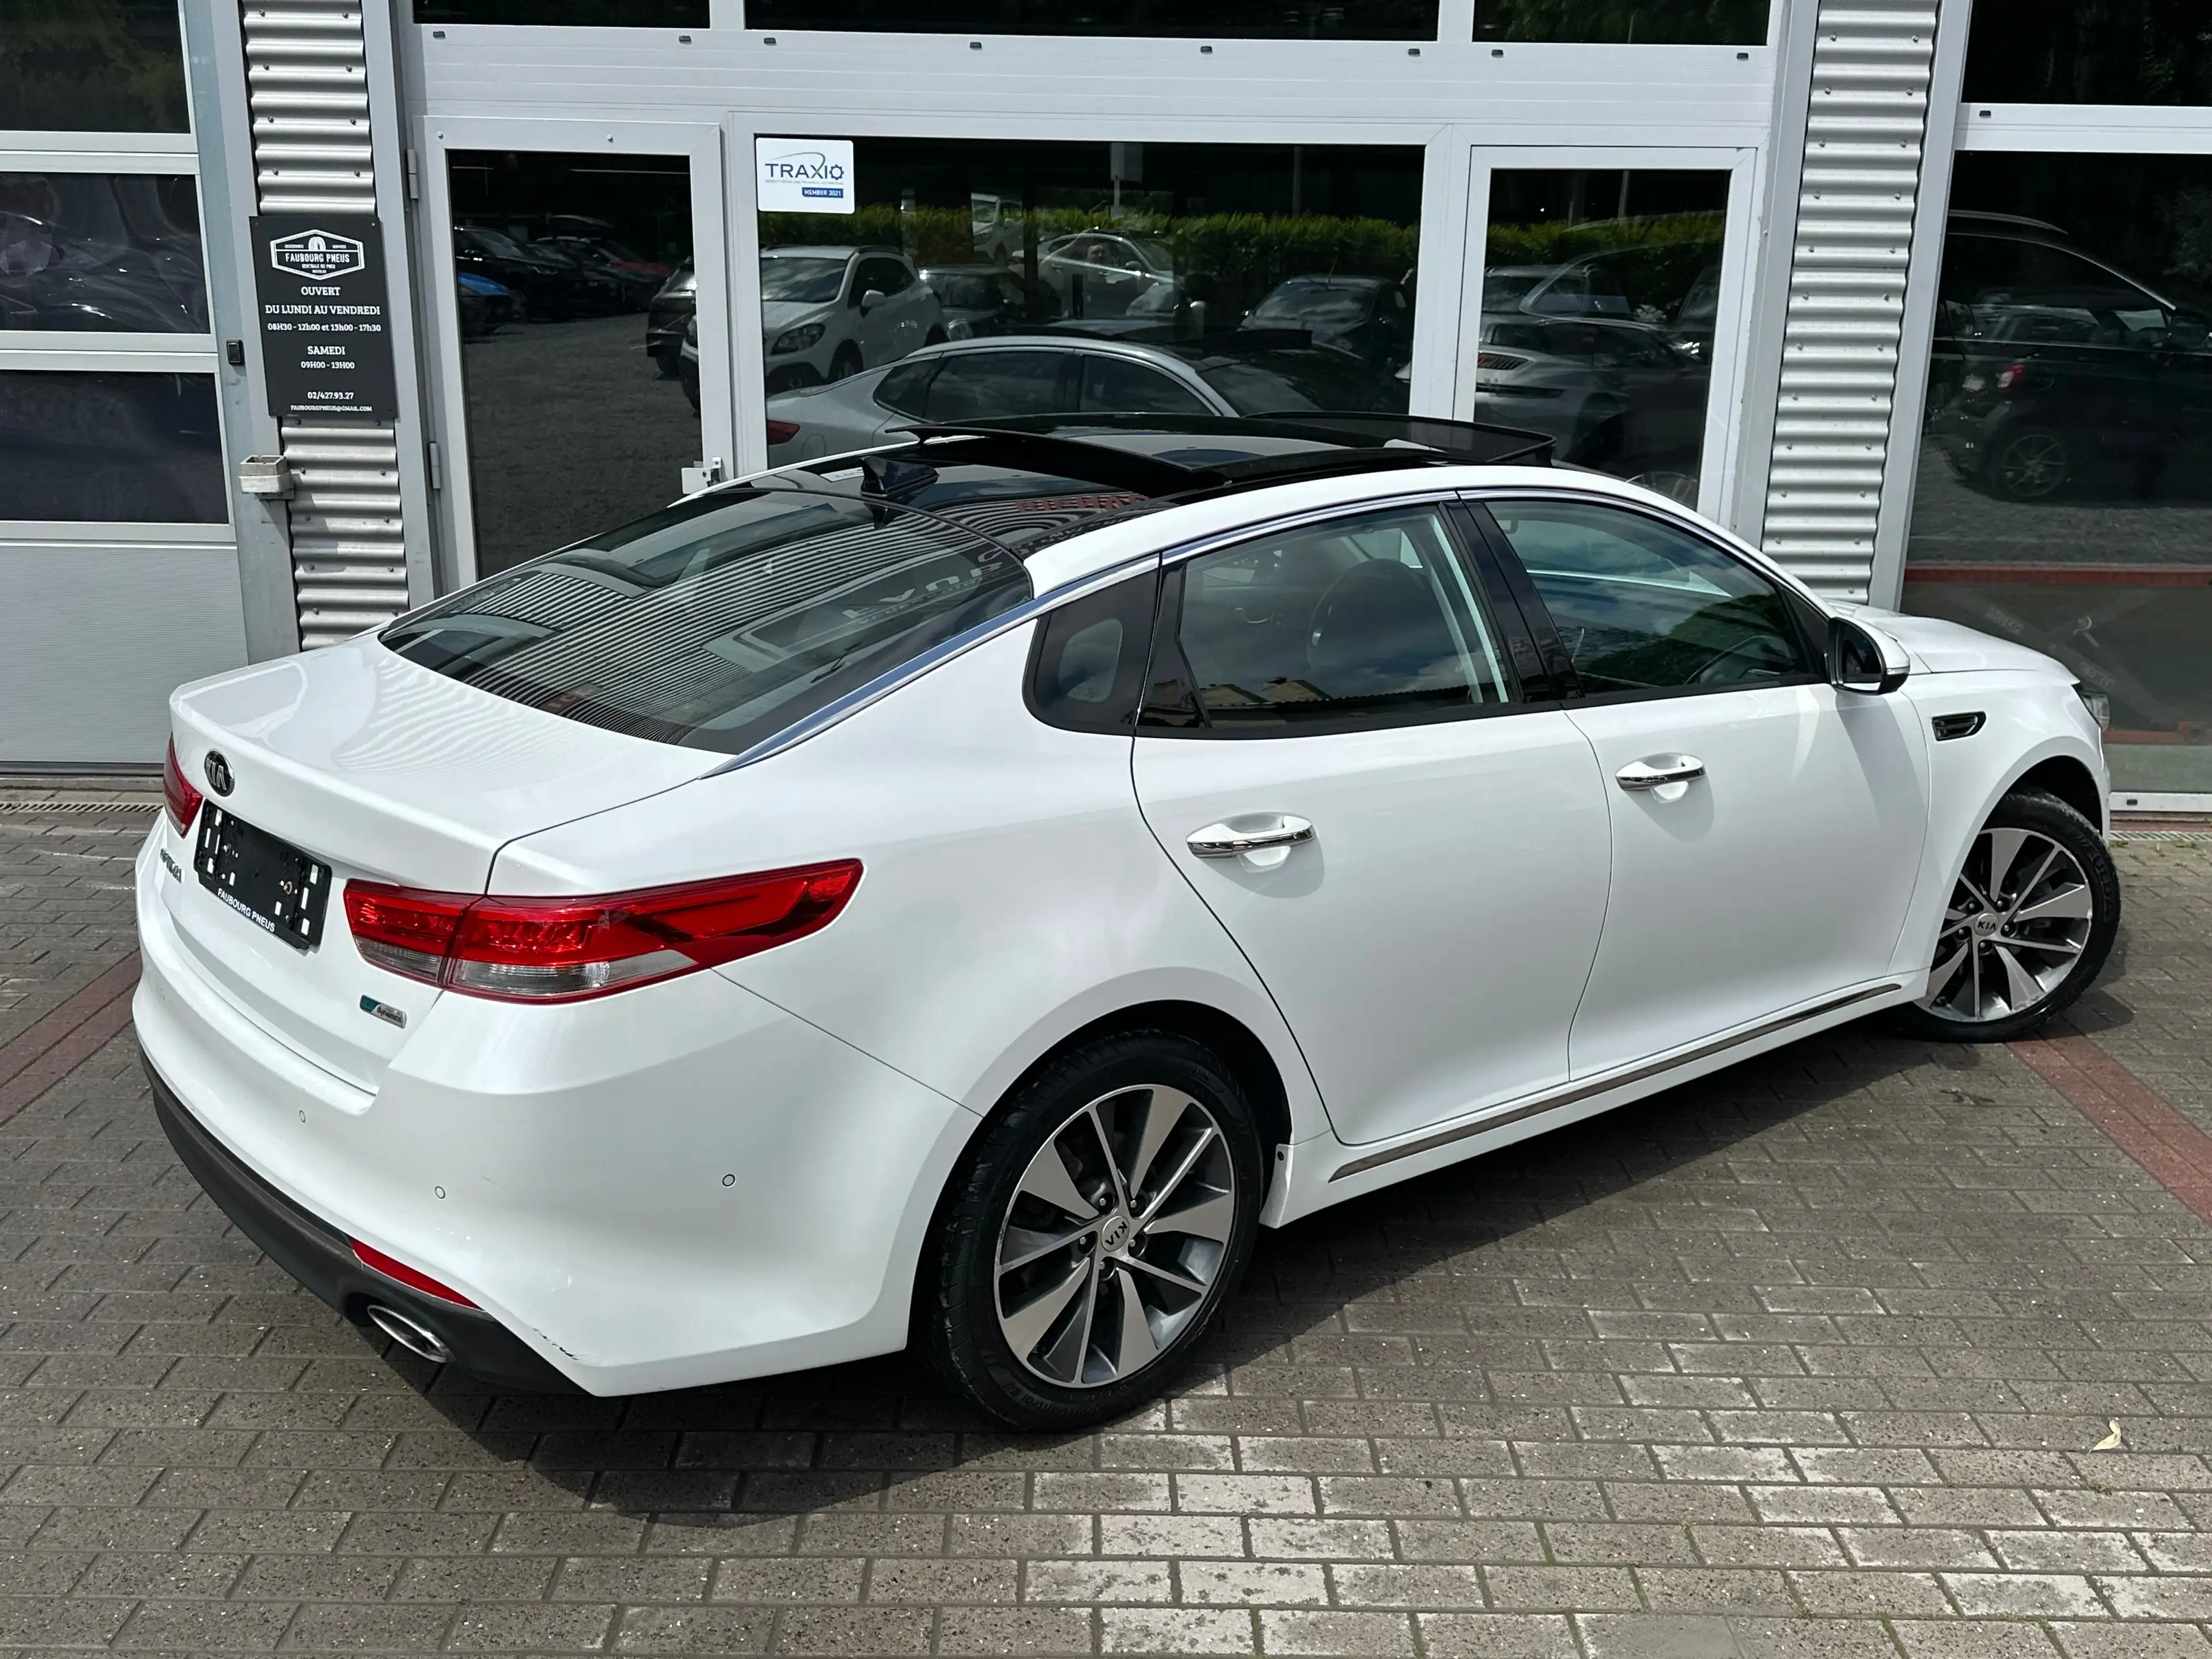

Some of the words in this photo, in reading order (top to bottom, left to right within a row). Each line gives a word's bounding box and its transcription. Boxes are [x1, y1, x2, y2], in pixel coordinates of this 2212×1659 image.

[765, 162, 844, 180] TRAXIO
[285, 253, 324, 263] FAUBOURG
[326, 253, 350, 263] PNEUS
[301, 286, 341, 296] OUVERT
[265, 305, 279, 313] DU
[281, 305, 312, 315] LUNDI
[313, 305, 328, 315] AU
[329, 305, 381, 315] VENDREDI
[268, 323, 292, 331] 08H30
[297, 323, 320, 331] 12h00
[330, 323, 353, 332] 13h00
[358, 324, 381, 332] 17h30
[307, 346, 346, 355] SAMEDI
[301, 361, 325, 369] 09H00
[331, 361, 355, 369] 13H00
[206, 756, 228, 791] KIA
[217, 887, 251, 918] FAUBOURG
[251, 910, 275, 933] PNEUS
[1977, 921, 1996, 931] KIA
[1104, 1221, 1128, 1246] KIA
